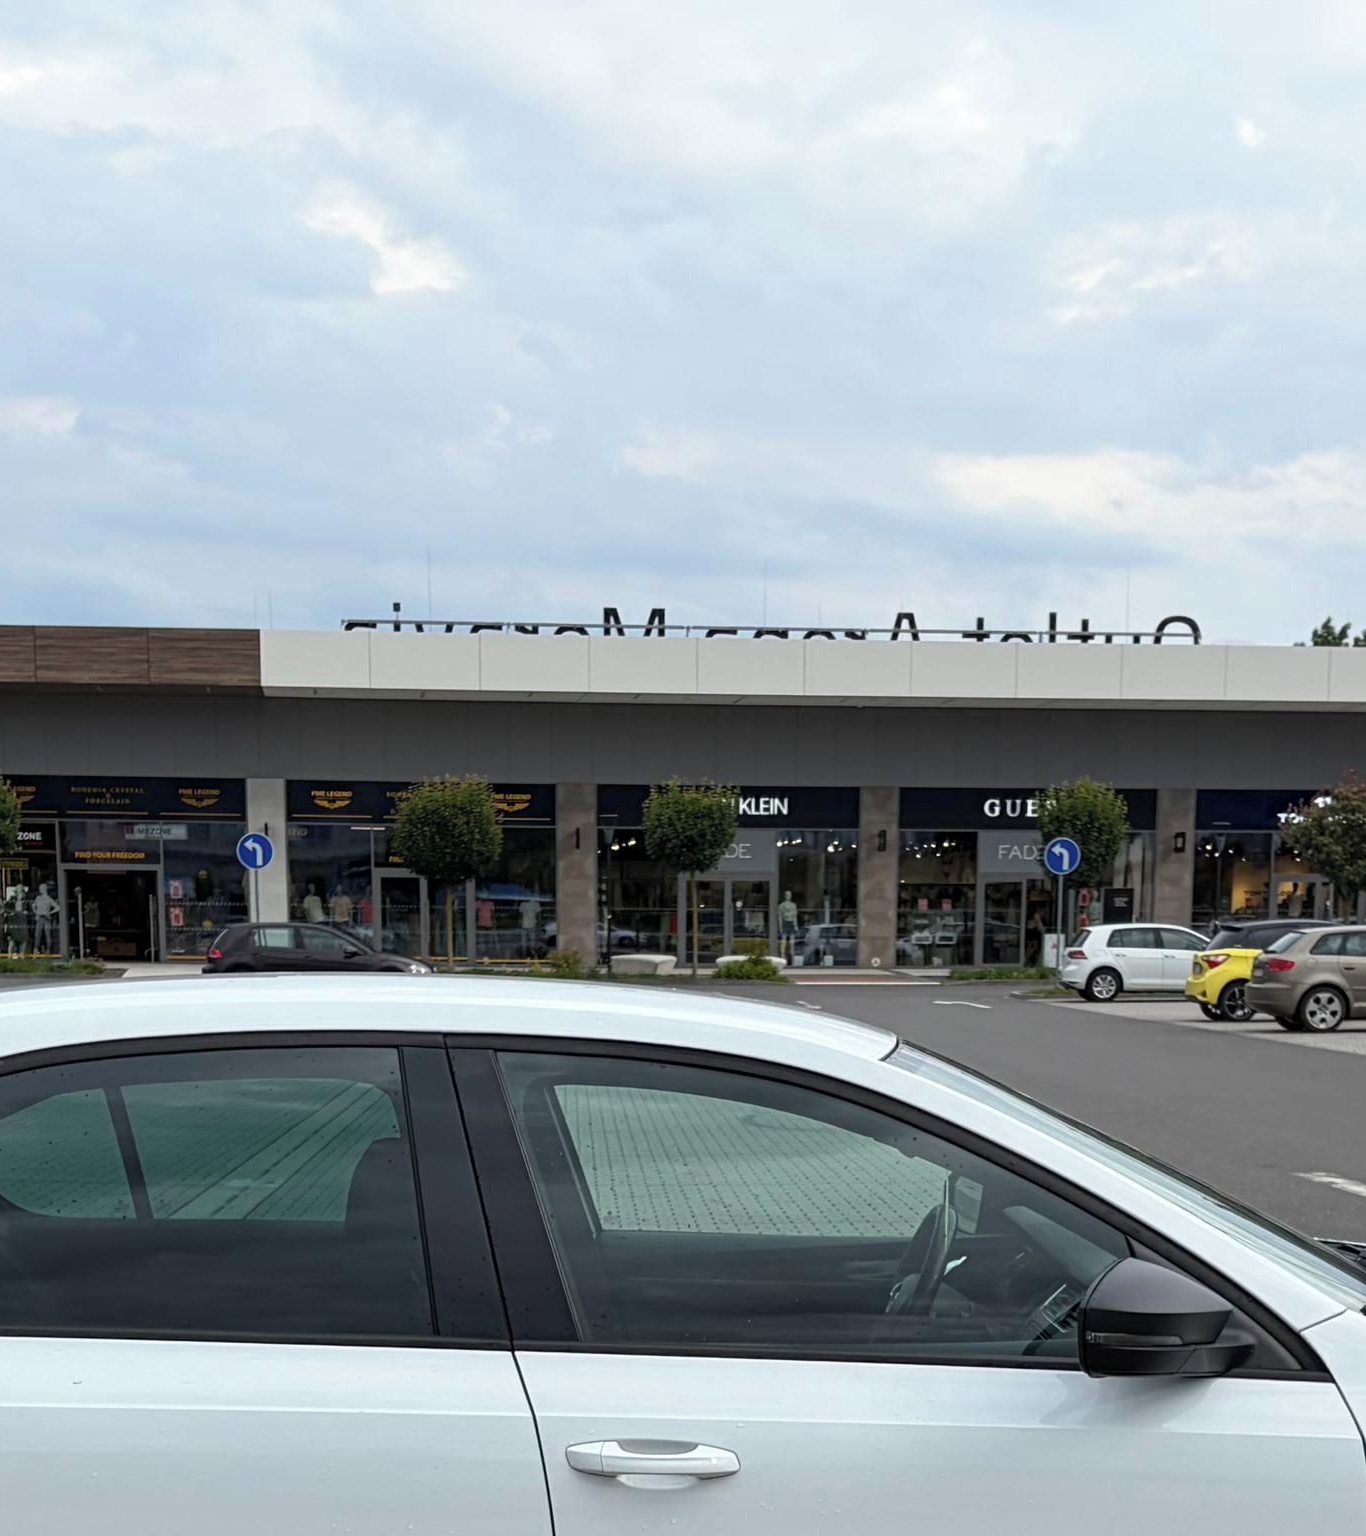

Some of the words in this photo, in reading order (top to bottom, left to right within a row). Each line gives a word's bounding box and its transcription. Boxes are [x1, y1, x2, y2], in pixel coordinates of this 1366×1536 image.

[194, 788, 221, 796] LEGEND
[326, 790, 353, 798] LEGEND
[505, 793, 532, 801] LEGEND
[738, 797, 789, 816] KLEIN
[983, 798, 1057, 817] GUE
[16, 831, 42, 841] ZONE
[724, 843, 752, 859] DE
